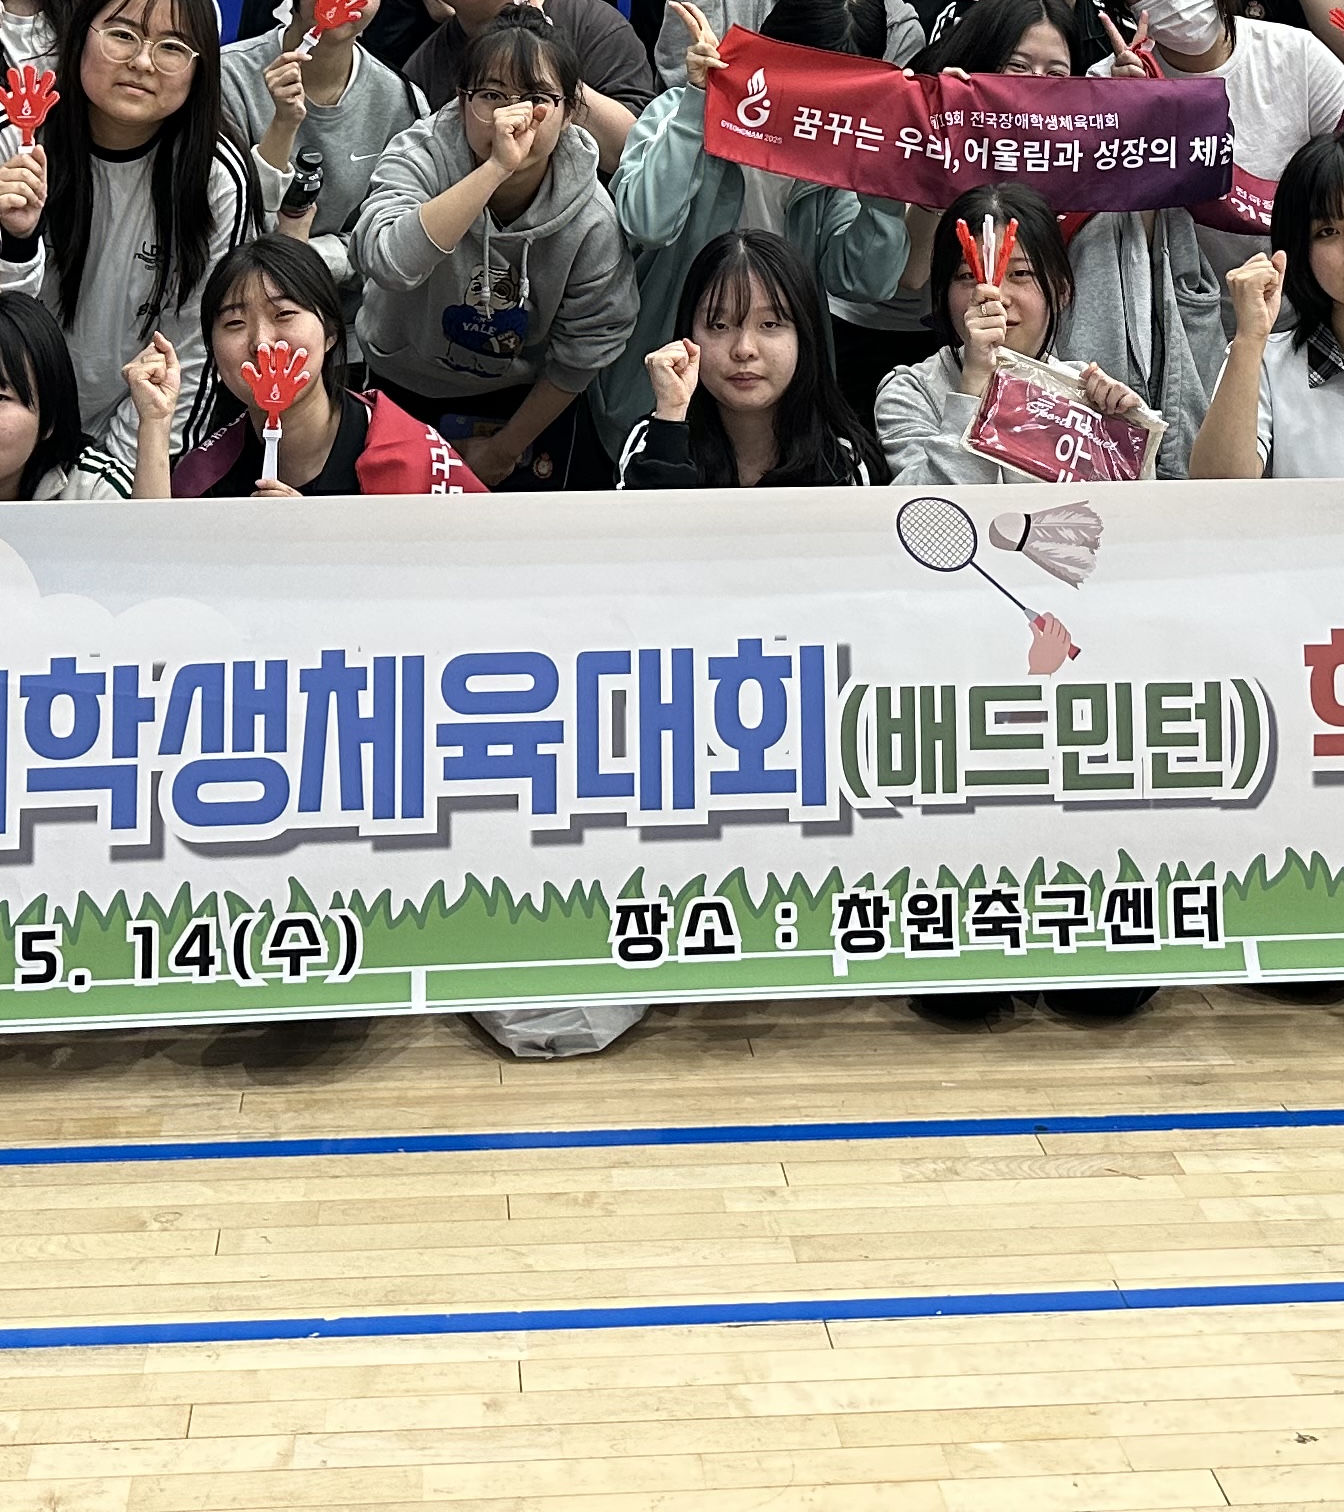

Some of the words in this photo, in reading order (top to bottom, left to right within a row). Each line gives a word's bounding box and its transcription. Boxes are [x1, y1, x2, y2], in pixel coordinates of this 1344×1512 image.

[792, 104, 887, 152] 꿈꾸는
[895, 126, 960, 176] 우리,
[964, 135, 1083, 173] 어울림과
[1094, 134, 1177, 172] 성장의
[970, 110, 1120, 131] 전국장애학생체육대회
[20, 928, 88, 988] 5.
[131, 914, 364, 982] 14(수)
[613, 901, 739, 964] 장소
[837, 885, 1221, 954] 창원축구센터
